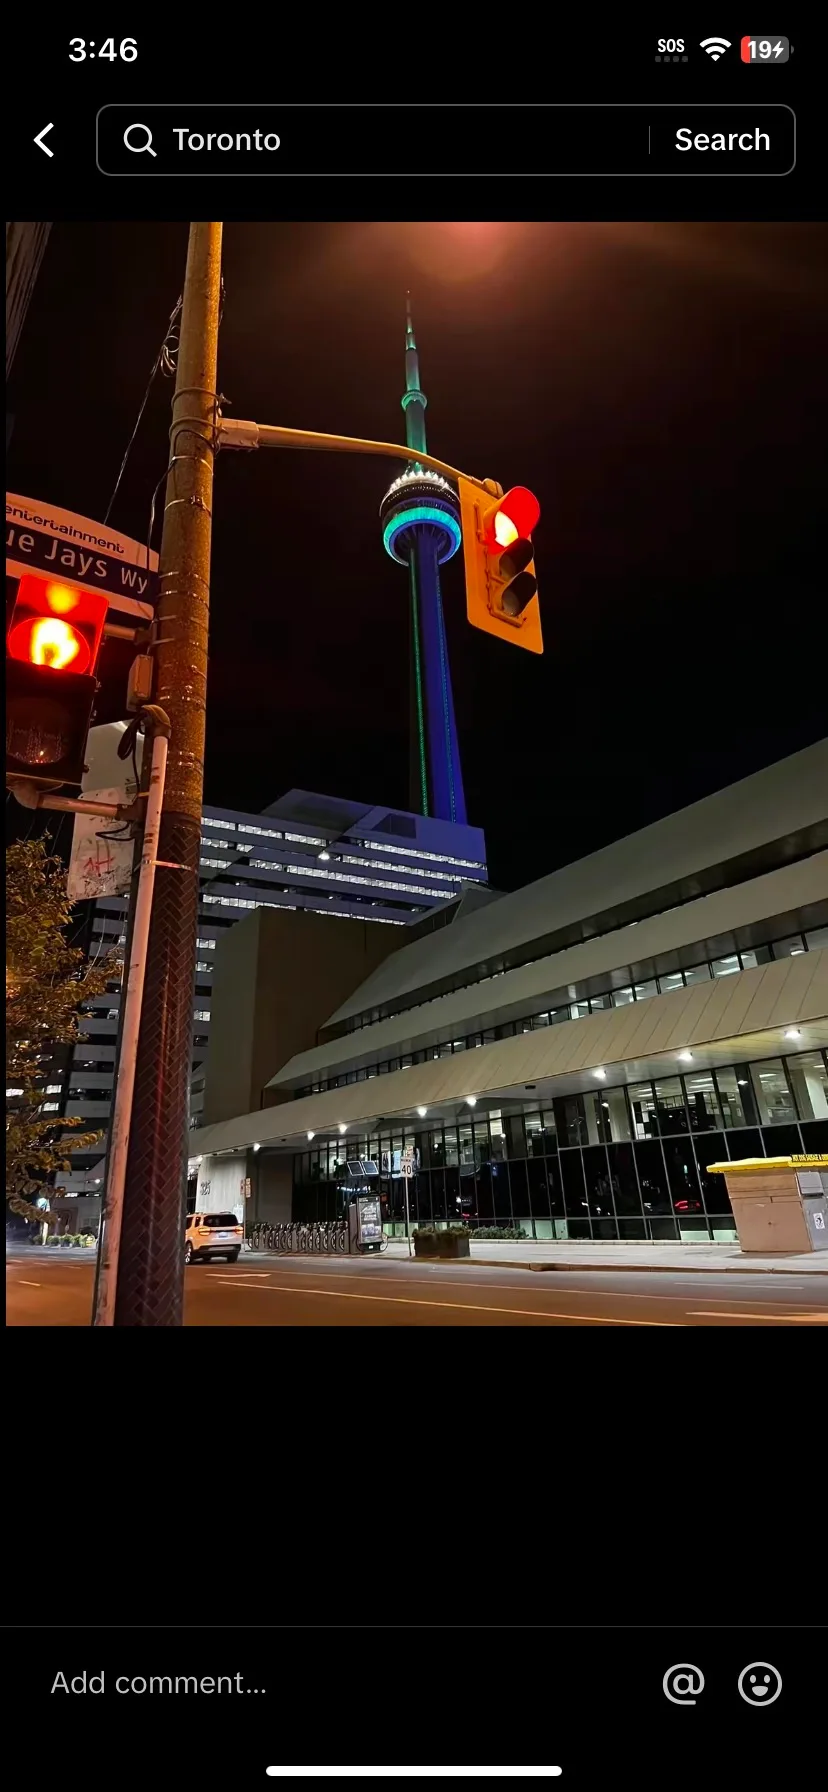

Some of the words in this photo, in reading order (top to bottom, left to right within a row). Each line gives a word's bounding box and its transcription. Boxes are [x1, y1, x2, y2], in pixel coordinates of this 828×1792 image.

[6, 505, 125, 554] entertainment
[44, 539, 108, 578] Jays
[121, 567, 148, 594] Wy
[401, 1164, 412, 1175] 40
